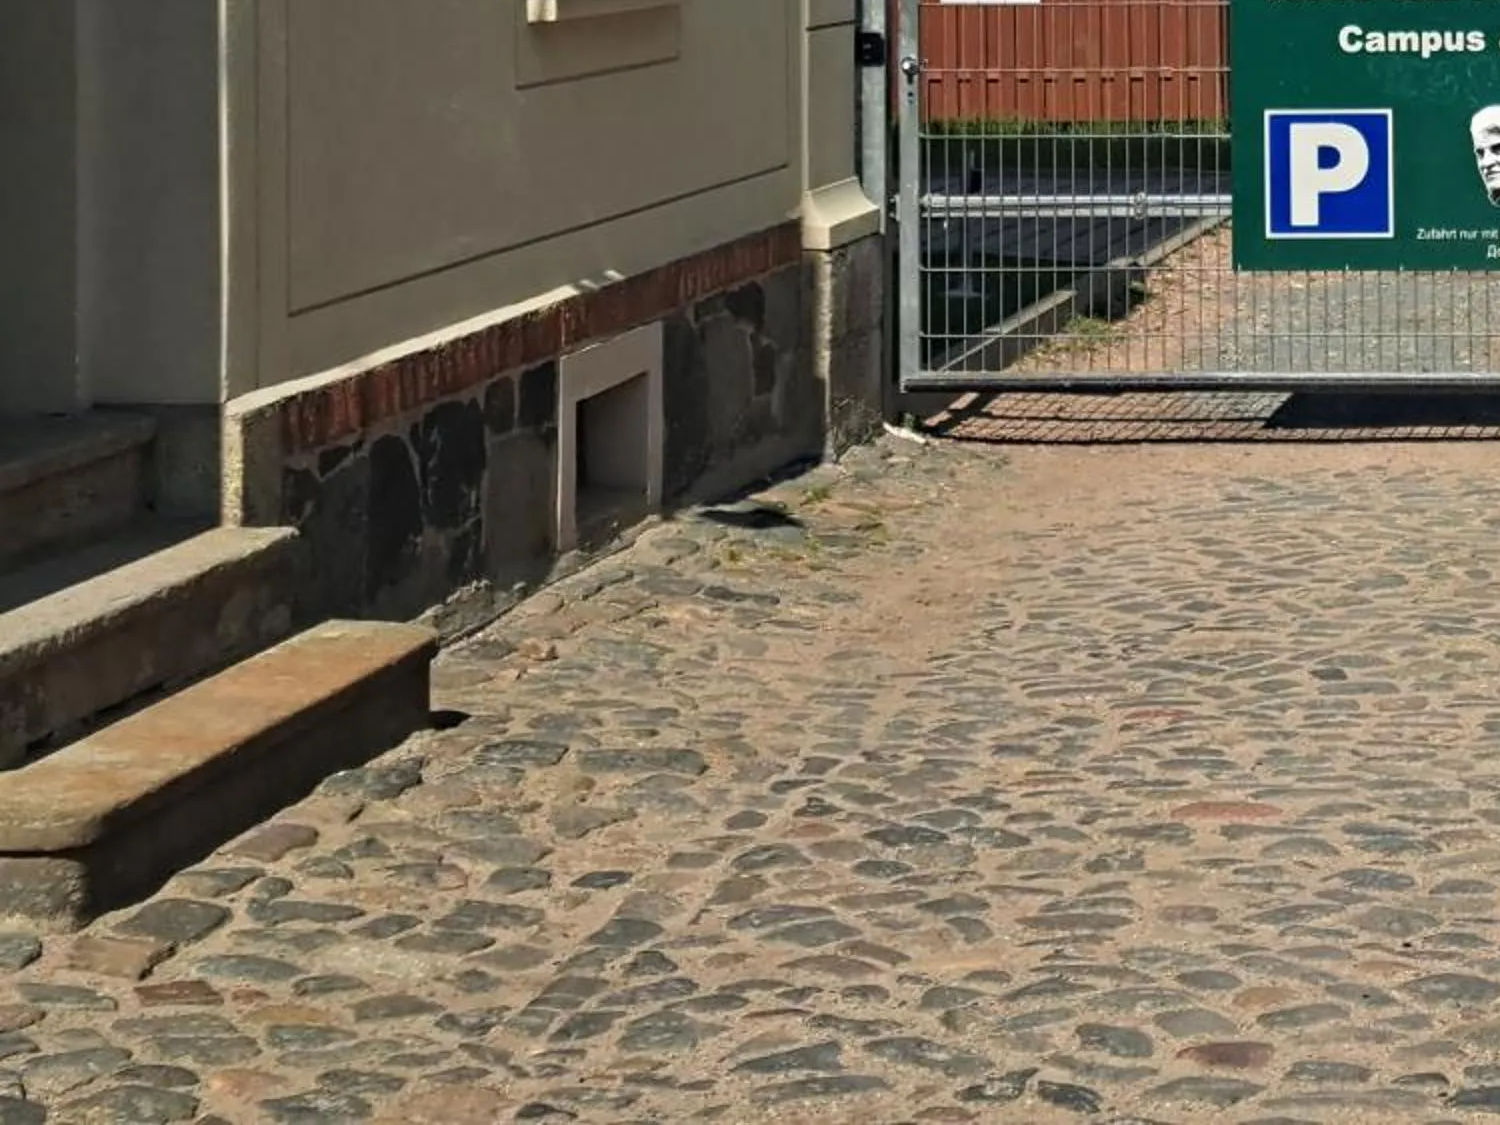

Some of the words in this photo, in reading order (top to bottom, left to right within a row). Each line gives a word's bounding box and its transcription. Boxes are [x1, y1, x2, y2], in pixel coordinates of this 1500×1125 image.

[1338, 24, 1487, 59] Campus
[1289, 122, 1370, 227] P
[1416, 227, 1457, 240] Zufahrt
[1459, 229, 1478, 240] nur
[1481, 228, 1499, 240] mit
